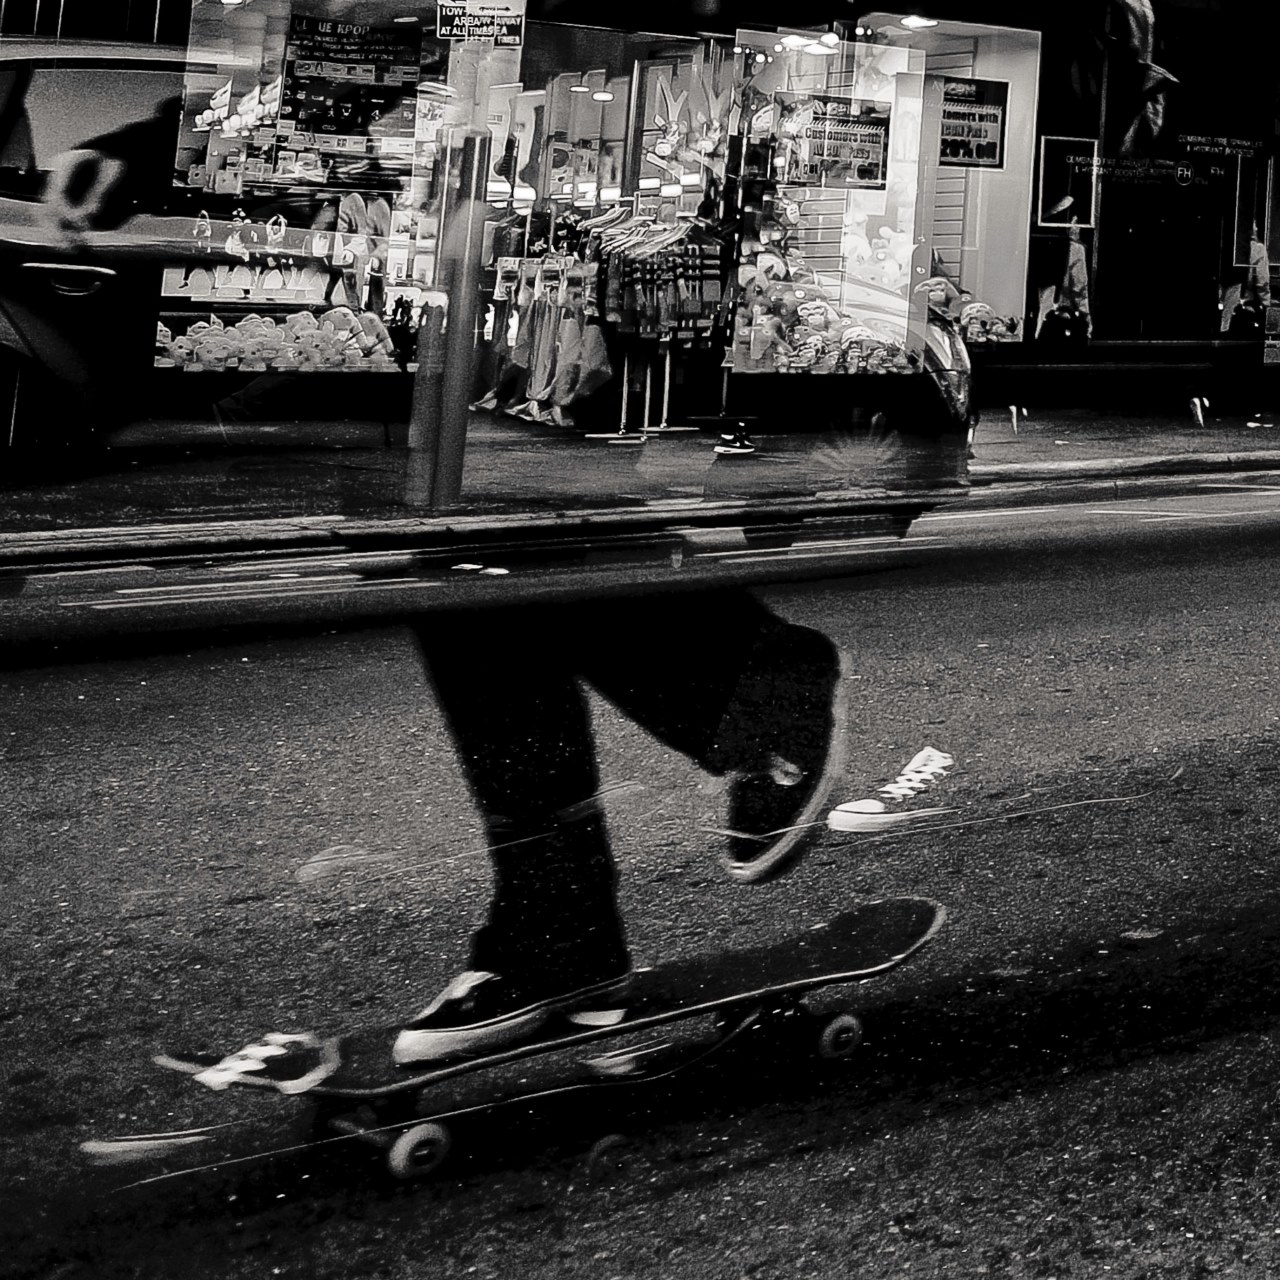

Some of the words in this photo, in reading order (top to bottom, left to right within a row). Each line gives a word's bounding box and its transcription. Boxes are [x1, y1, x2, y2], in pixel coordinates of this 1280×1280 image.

[942, 108, 976, 122] tomers
[978, 112, 999, 123] with
[804, 126, 858, 141] Customers
[859, 131, 881, 143] with
[1178, 134, 1212, 144] COMBINED
[1213, 136, 1228, 146] FIRE
[1193, 145, 1224, 154] HYDRANT
[1066, 155, 1100, 164] COMBINED
[1101, 157, 1116, 166] FIRE
[1177, 169, 1192, 178] FH
